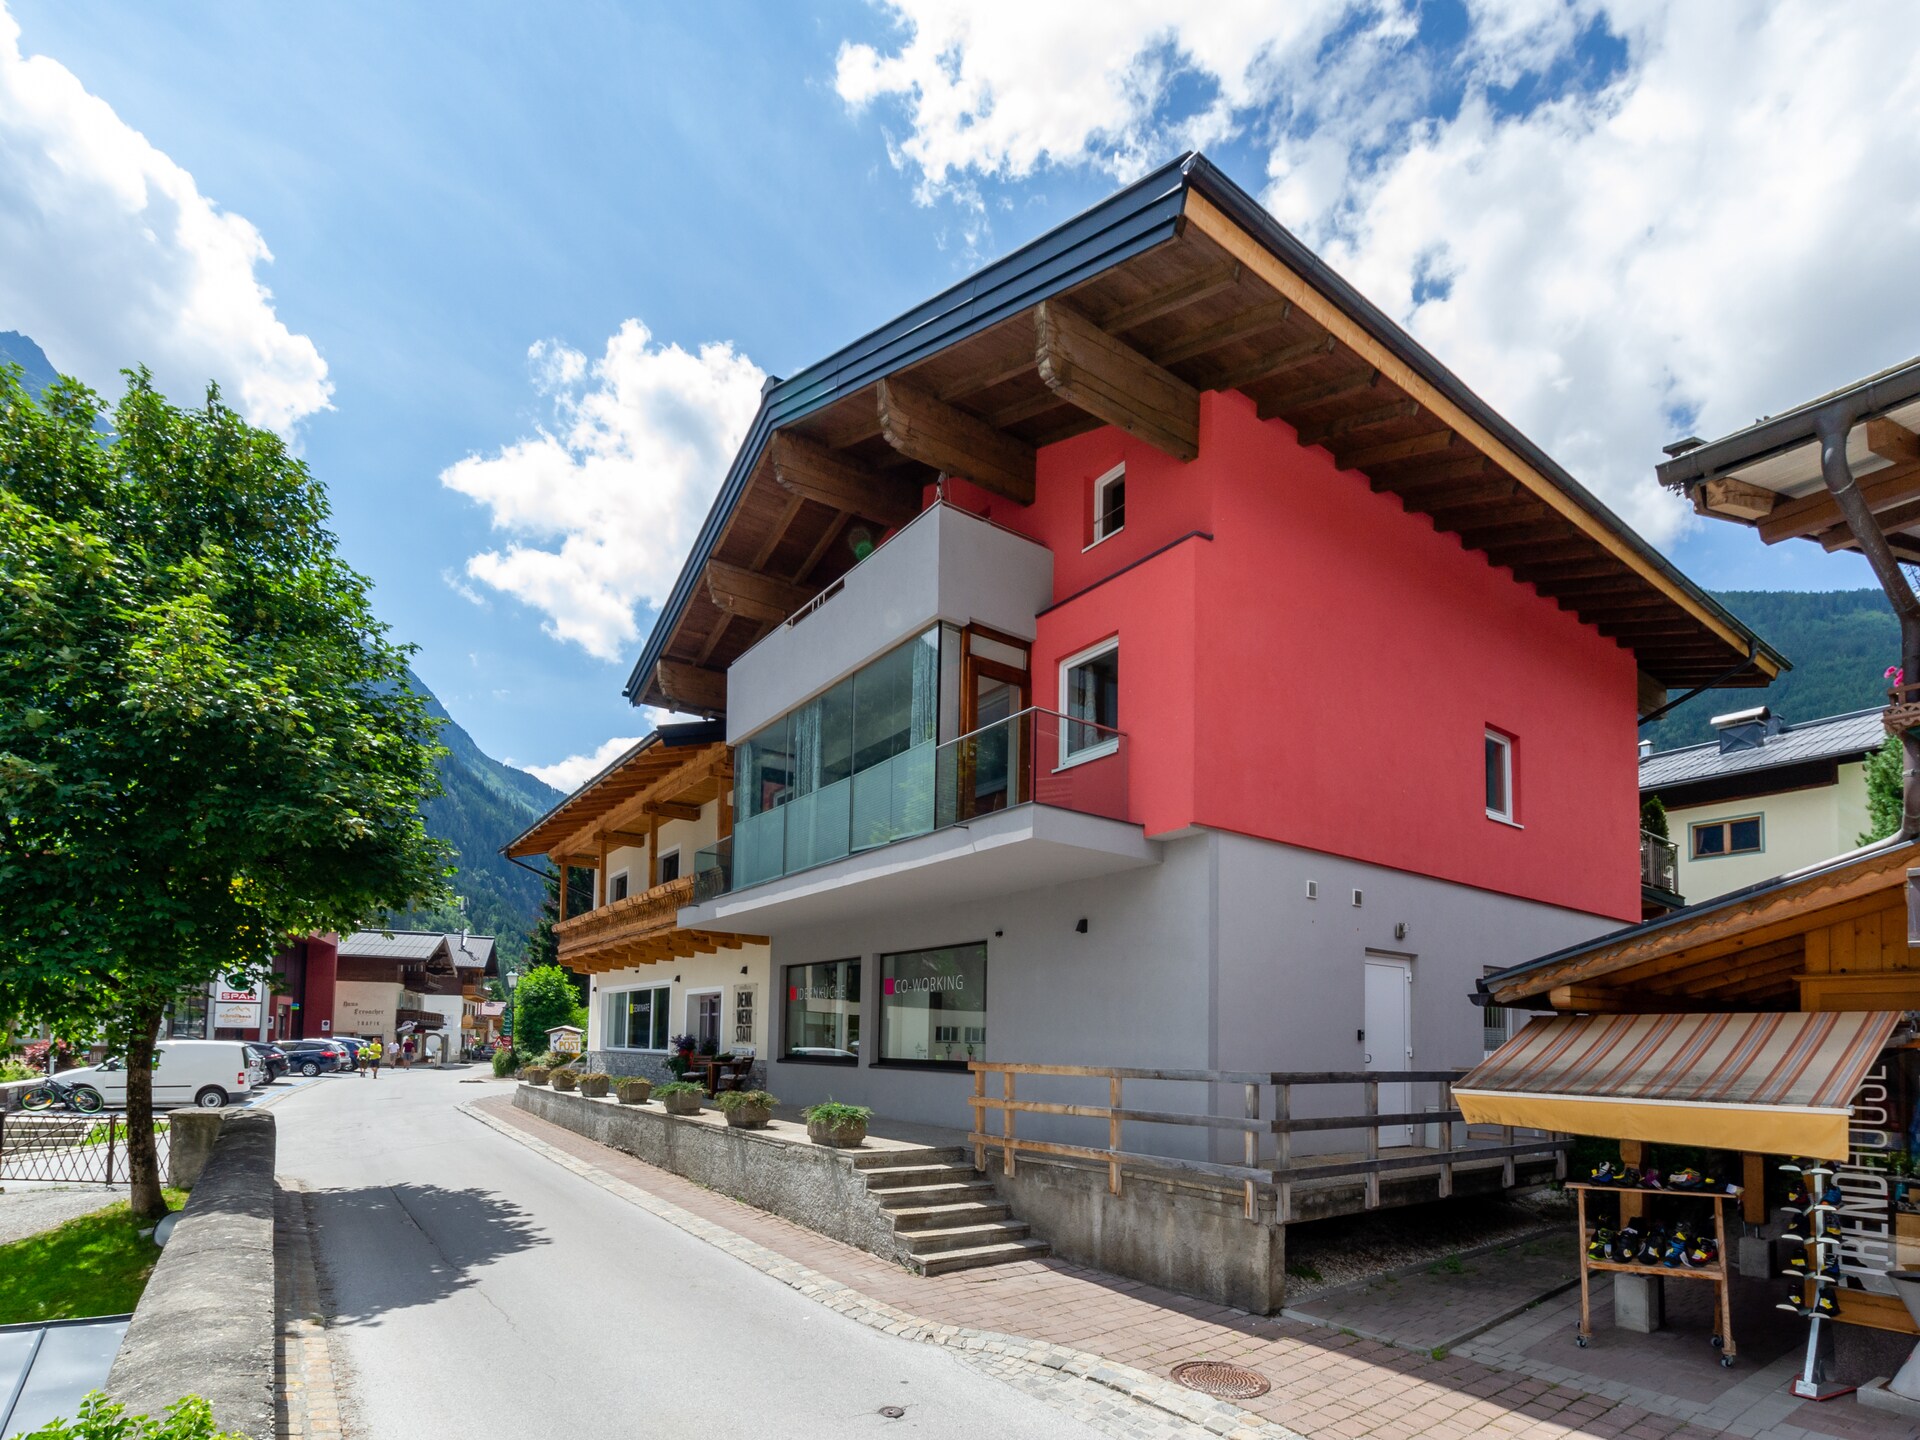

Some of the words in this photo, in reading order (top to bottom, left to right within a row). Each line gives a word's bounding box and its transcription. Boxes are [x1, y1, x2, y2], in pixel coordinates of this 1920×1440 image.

[894, 975, 964, 994] CO-WORKING
[737, 992, 753, 1008] DENK
[736, 1009, 753, 1025] WERK
[735, 1025, 752, 1042] STATT
[559, 1041, 580, 1051] POST
